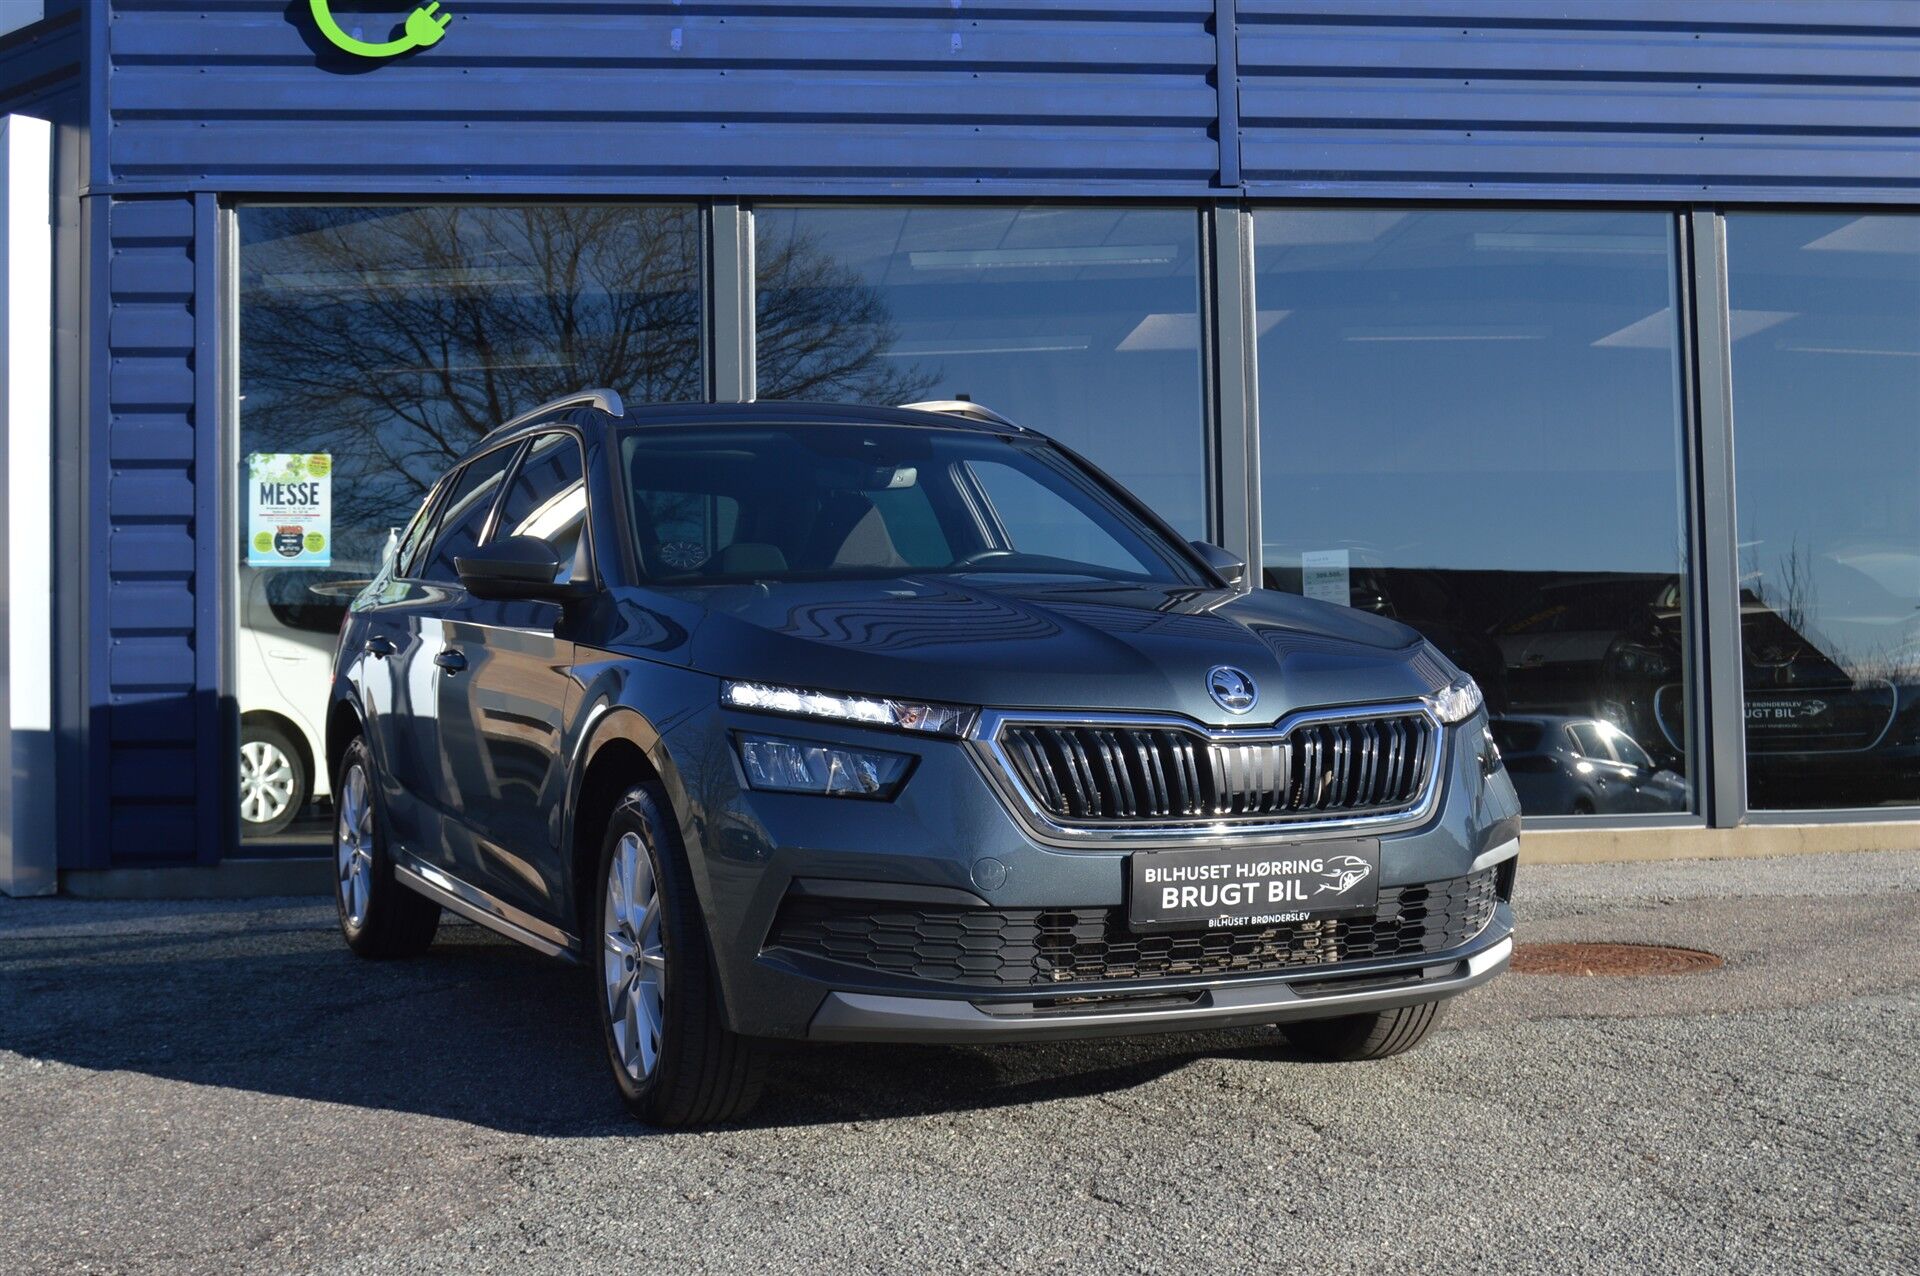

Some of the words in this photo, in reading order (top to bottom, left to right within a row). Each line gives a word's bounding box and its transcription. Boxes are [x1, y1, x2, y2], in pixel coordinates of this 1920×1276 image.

[260, 482, 320, 506] MESSE
[1775, 708, 1795, 718] BIL
[1144, 864, 1232, 883] BILHUSET
[1236, 858, 1324, 878] HJØRRING
[1161, 882, 1260, 909] BRUGT
[1268, 879, 1308, 902] BIL
[1208, 916, 1249, 928] BILHUSET
[1251, 911, 1311, 925] BRØNDERSLEV
